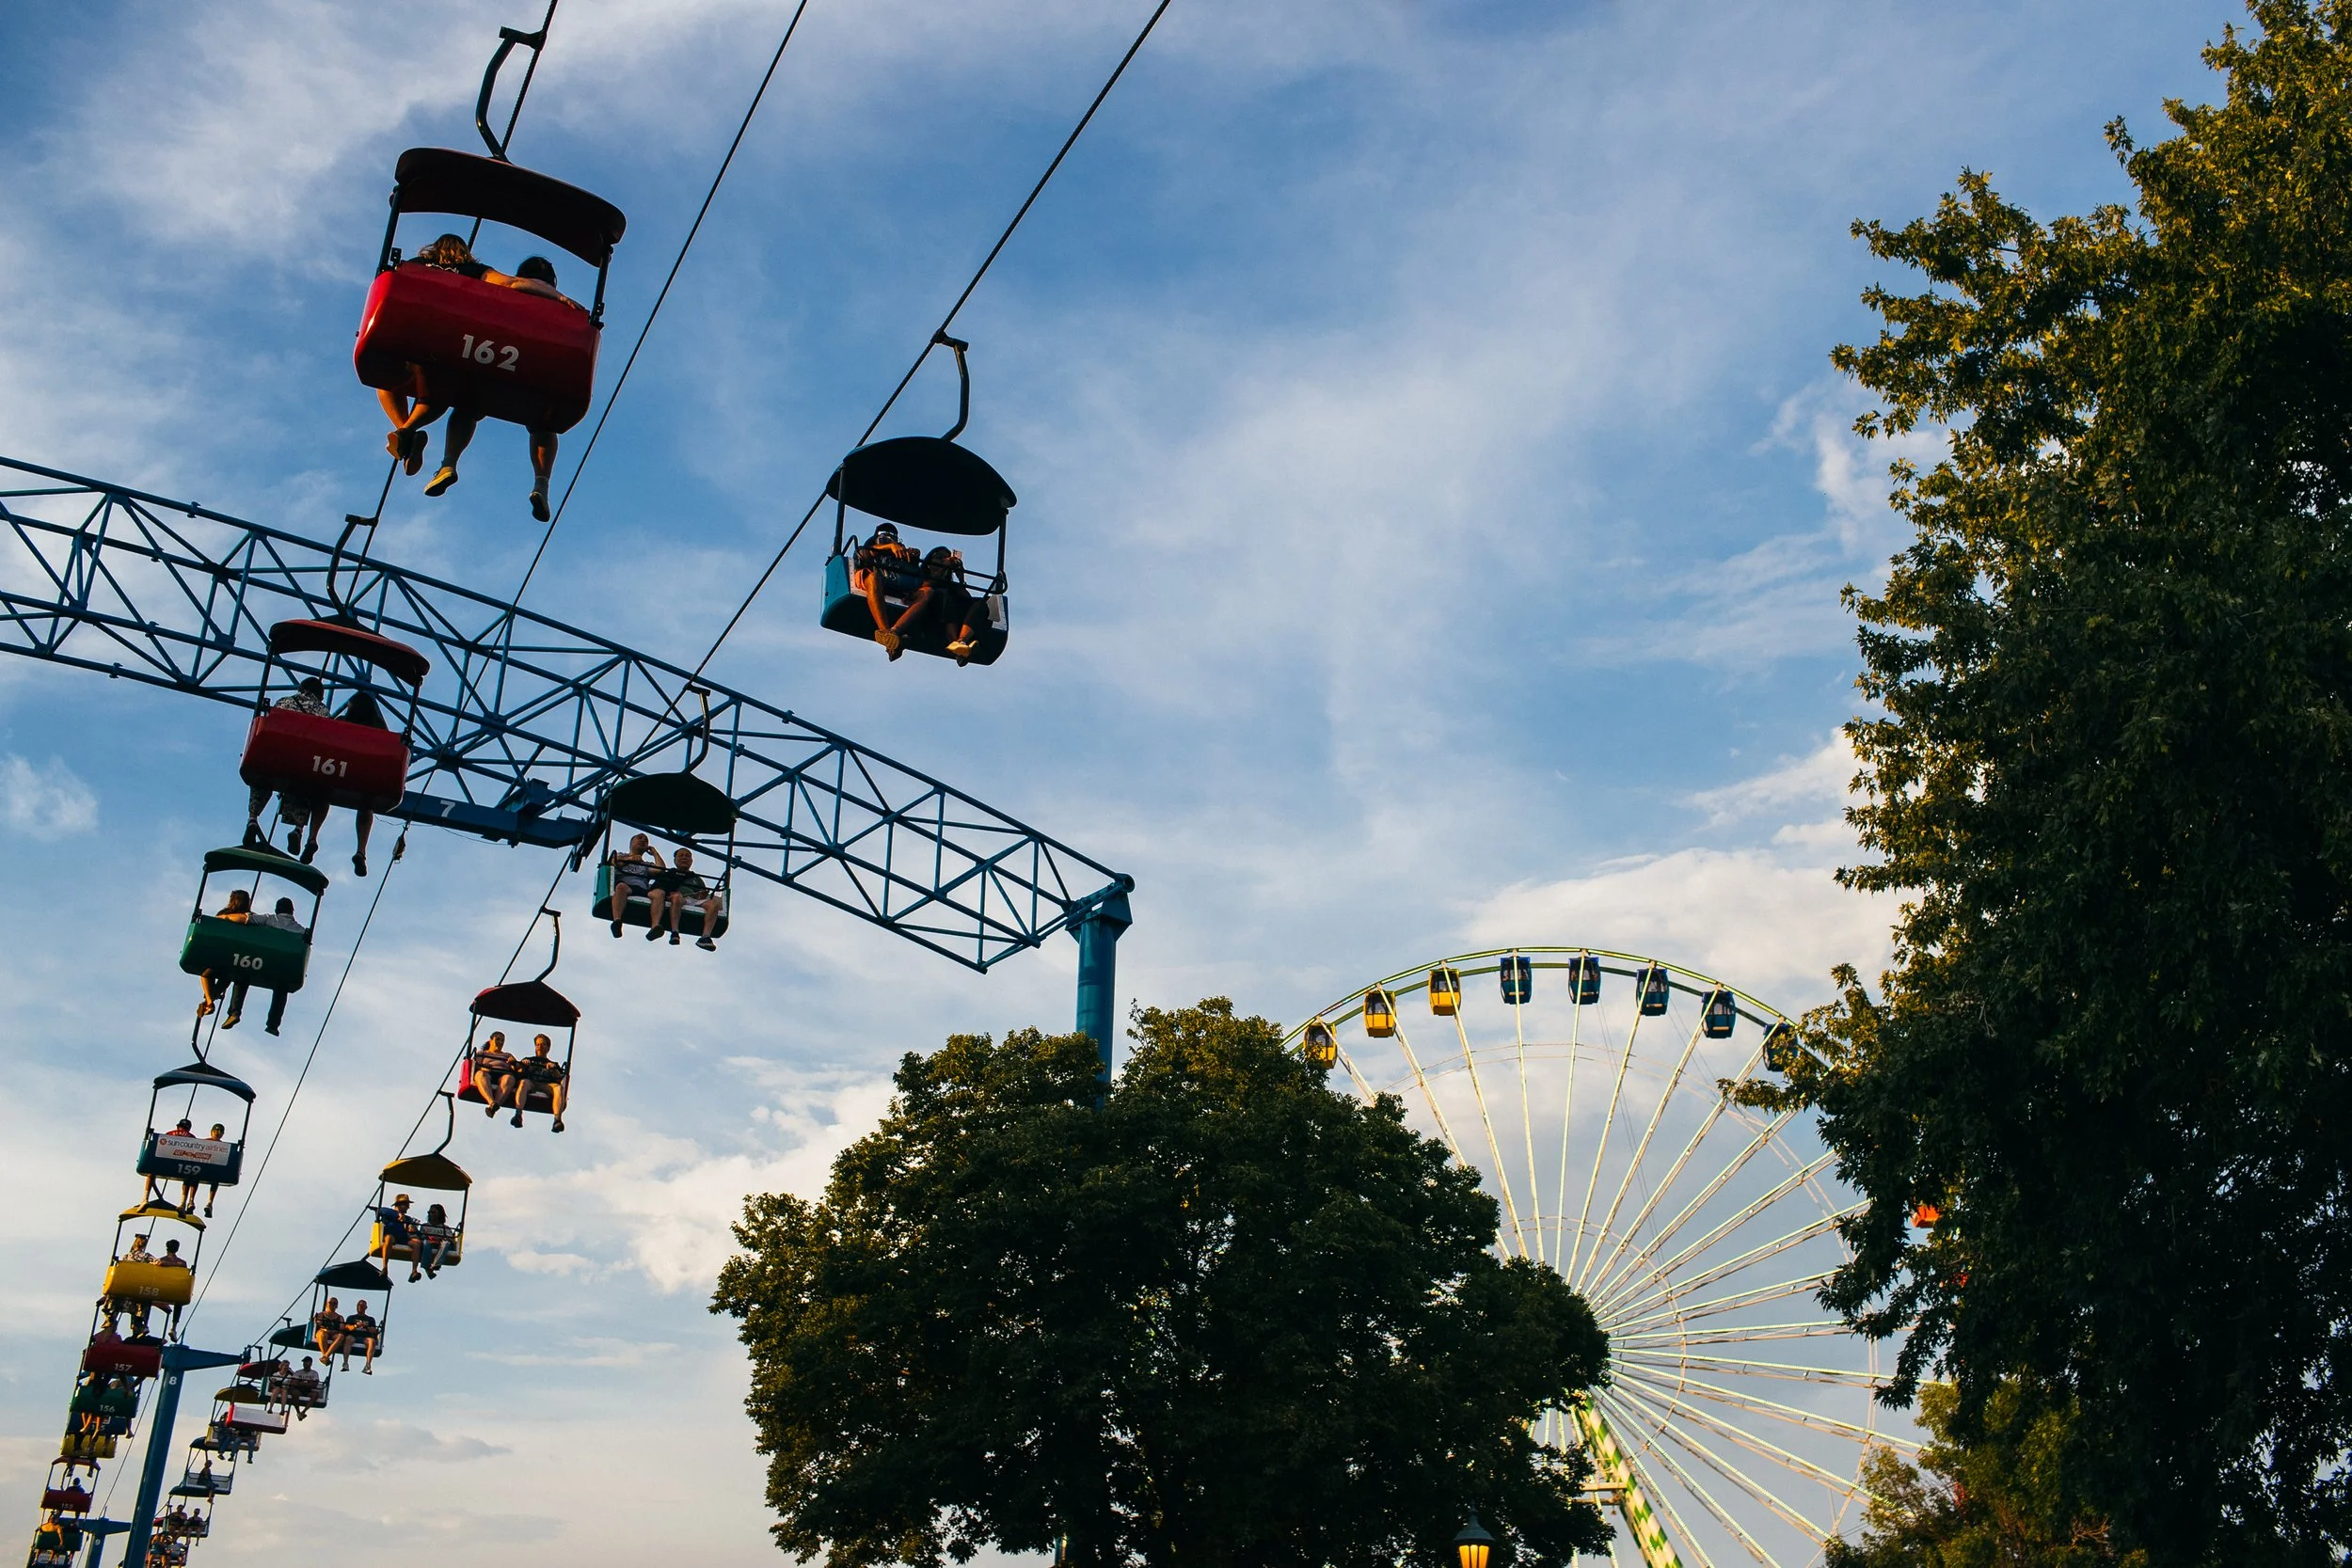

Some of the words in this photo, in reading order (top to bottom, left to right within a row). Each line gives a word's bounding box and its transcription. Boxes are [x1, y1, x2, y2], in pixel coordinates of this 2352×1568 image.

[462, 334, 519, 372] 162
[312, 755, 347, 778] 161
[440, 800, 456, 817] 7
[233, 953, 263, 970] 160
[181, 1141, 205, 1151] country
[178, 1164, 200, 1175] 159
[139, 1286, 160, 1296] 158
[114, 1363, 132, 1371] 157
[169, 1376, 178, 1386] 8
